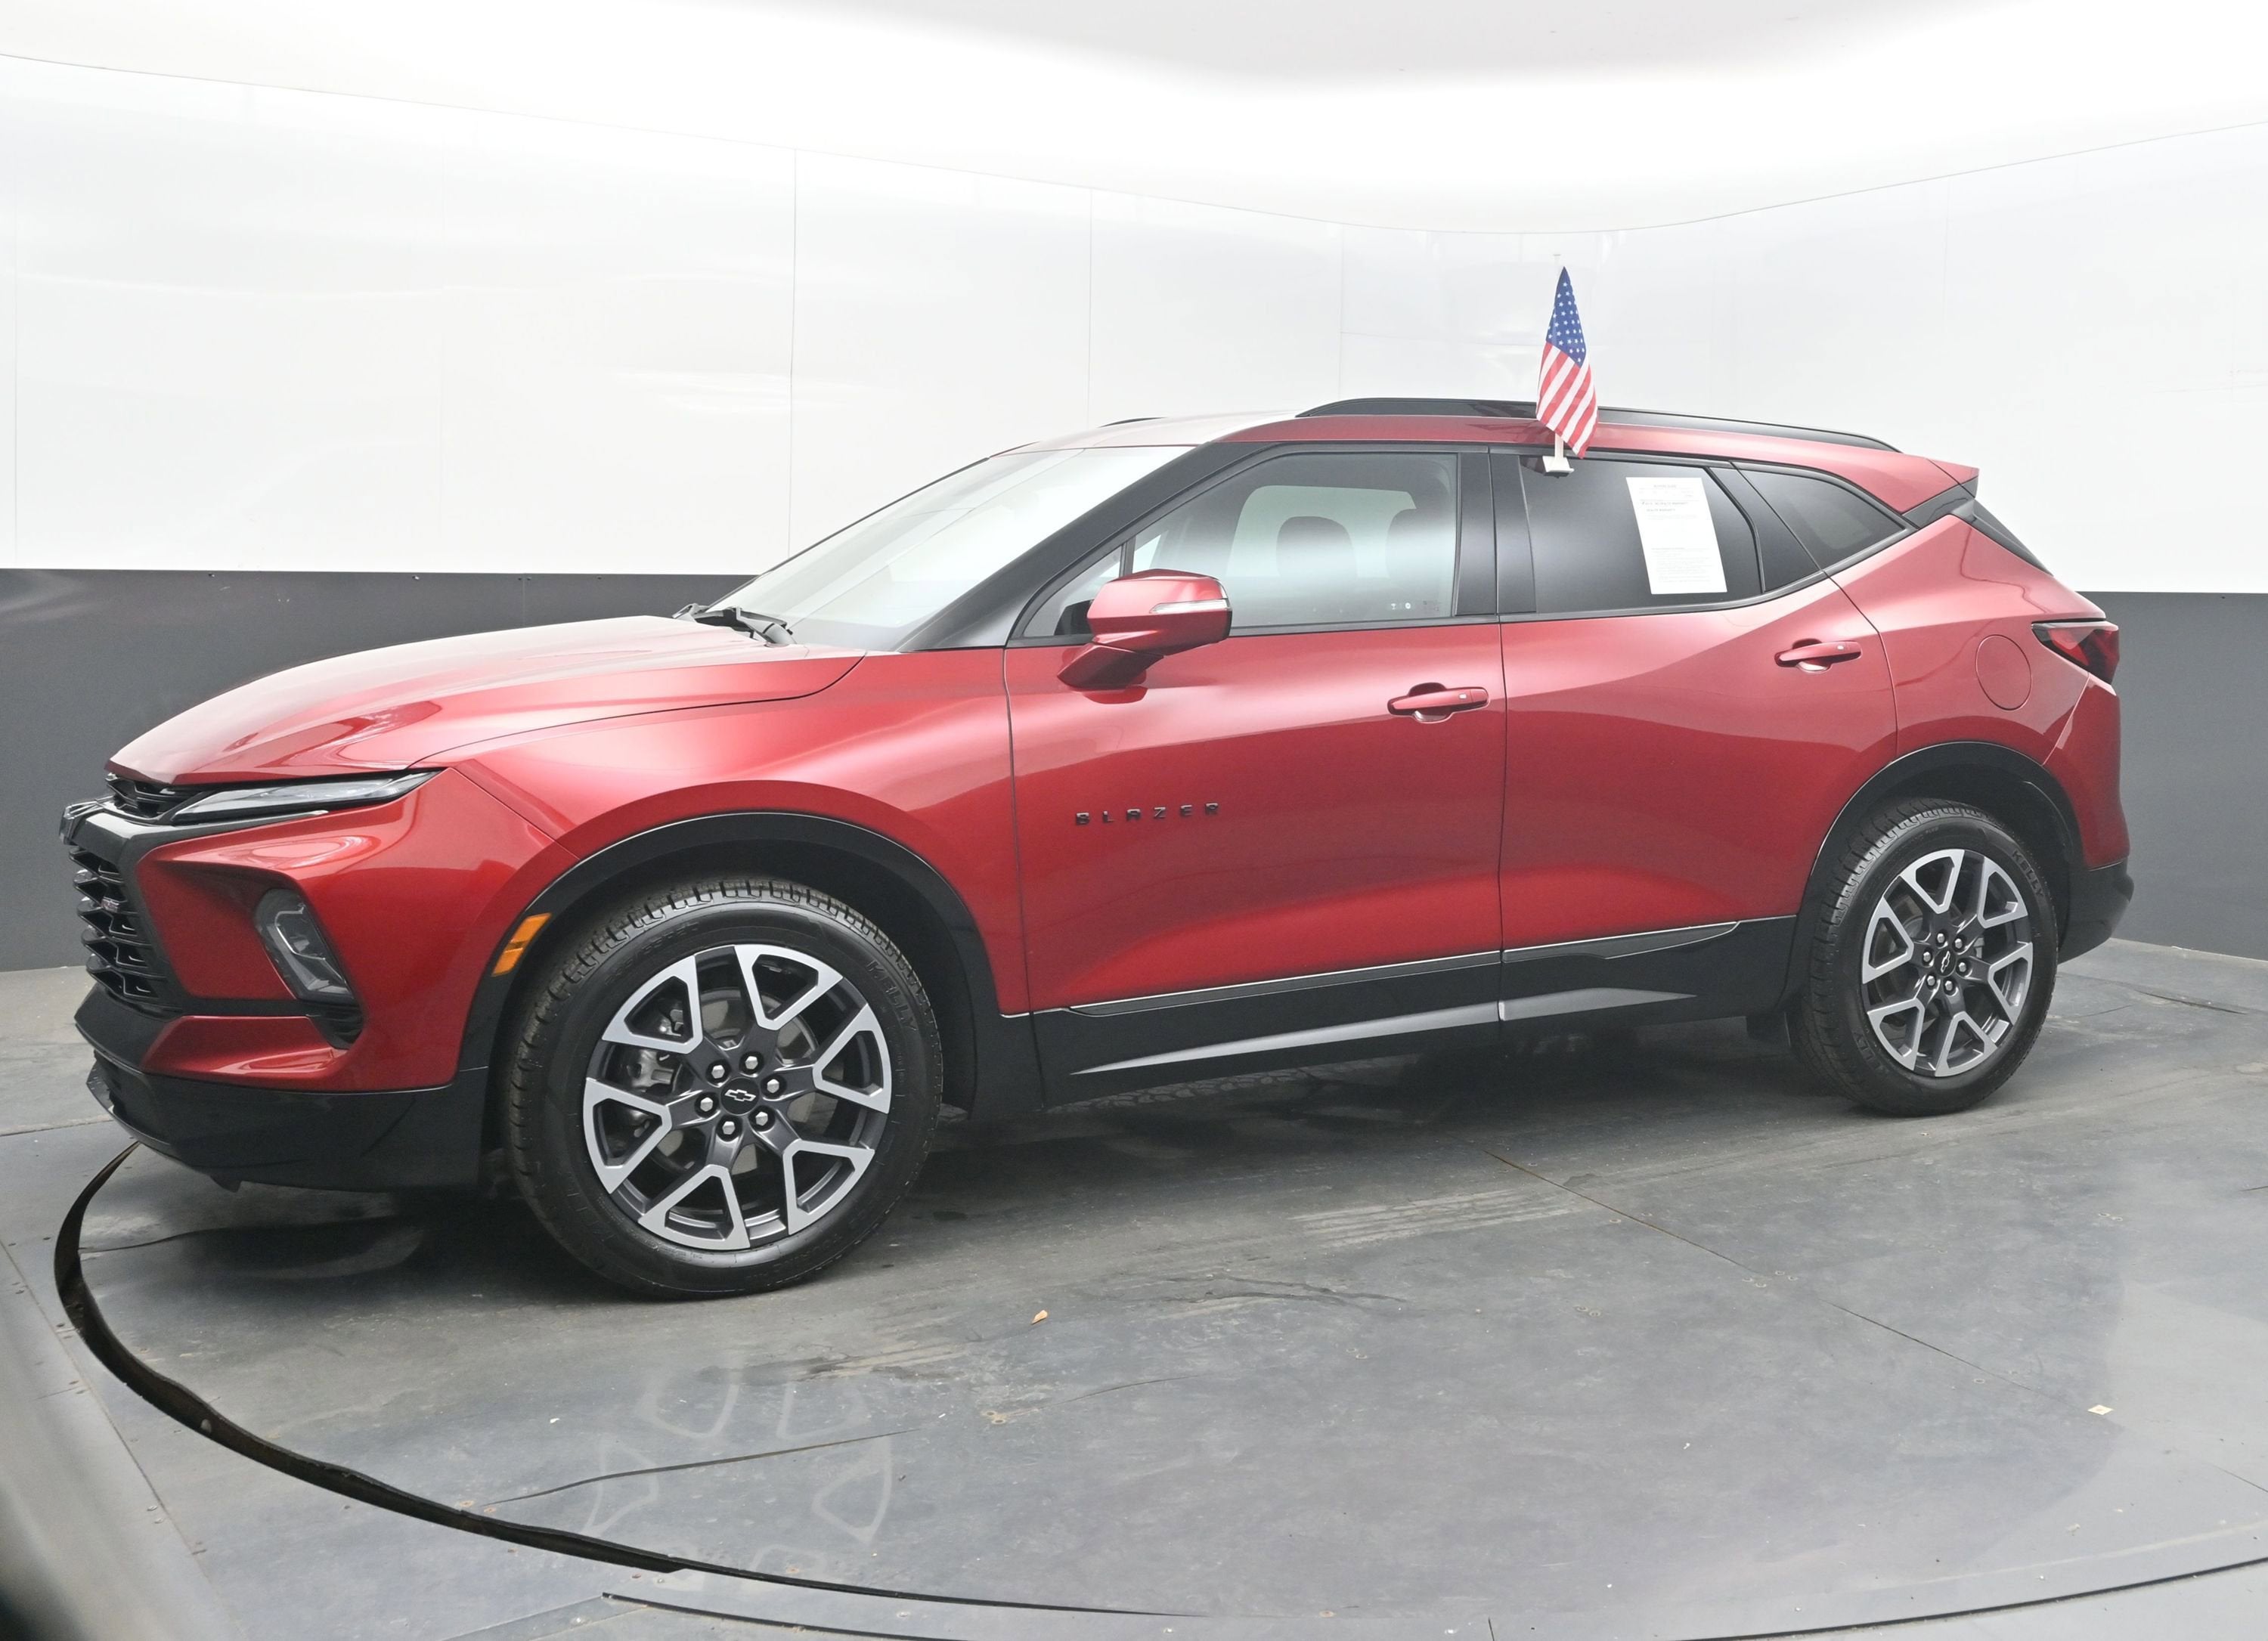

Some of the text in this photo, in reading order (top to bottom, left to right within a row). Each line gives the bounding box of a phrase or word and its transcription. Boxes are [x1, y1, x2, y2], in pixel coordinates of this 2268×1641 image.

[1075, 802, 1219, 825] BLAZER
[2012, 850, 2045, 898] KELLY
[866, 959, 919, 1031] KELLY
